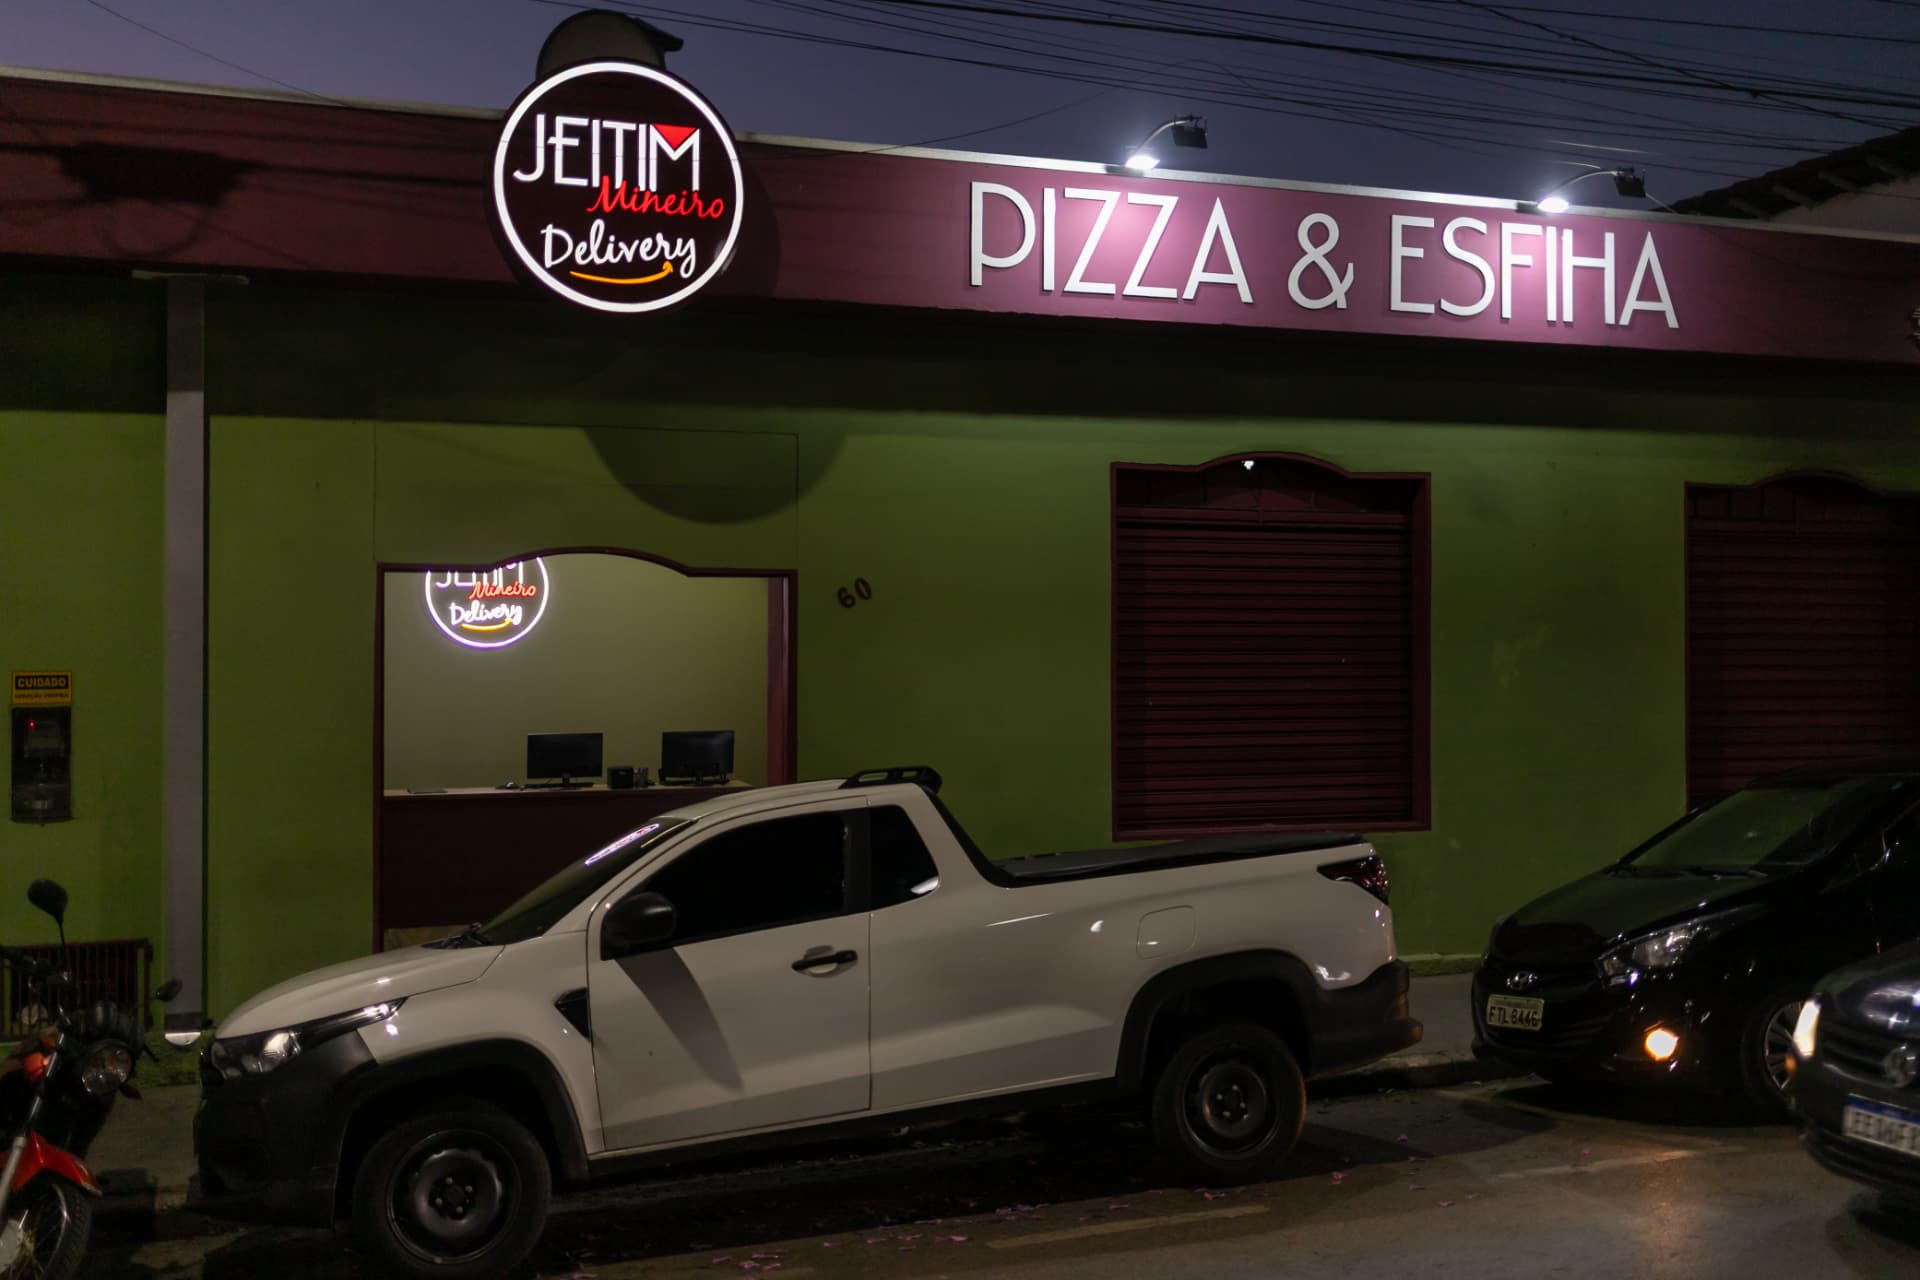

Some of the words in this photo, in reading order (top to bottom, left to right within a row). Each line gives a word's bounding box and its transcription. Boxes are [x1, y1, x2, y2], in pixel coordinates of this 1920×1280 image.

[513, 113, 700, 192] JEITIM
[586, 175, 724, 218] Mineiro
[540, 218, 697, 279] Delivery
[971, 181, 1253, 304] PIZZA
[1288, 212, 1354, 309] &
[1390, 214, 1679, 328] ESFIHA
[468, 580, 537, 600] Mineiro
[837, 577, 872, 608] 60
[449, 599, 522, 625] Delivery
[17, 677, 67, 688] CUIDADO
